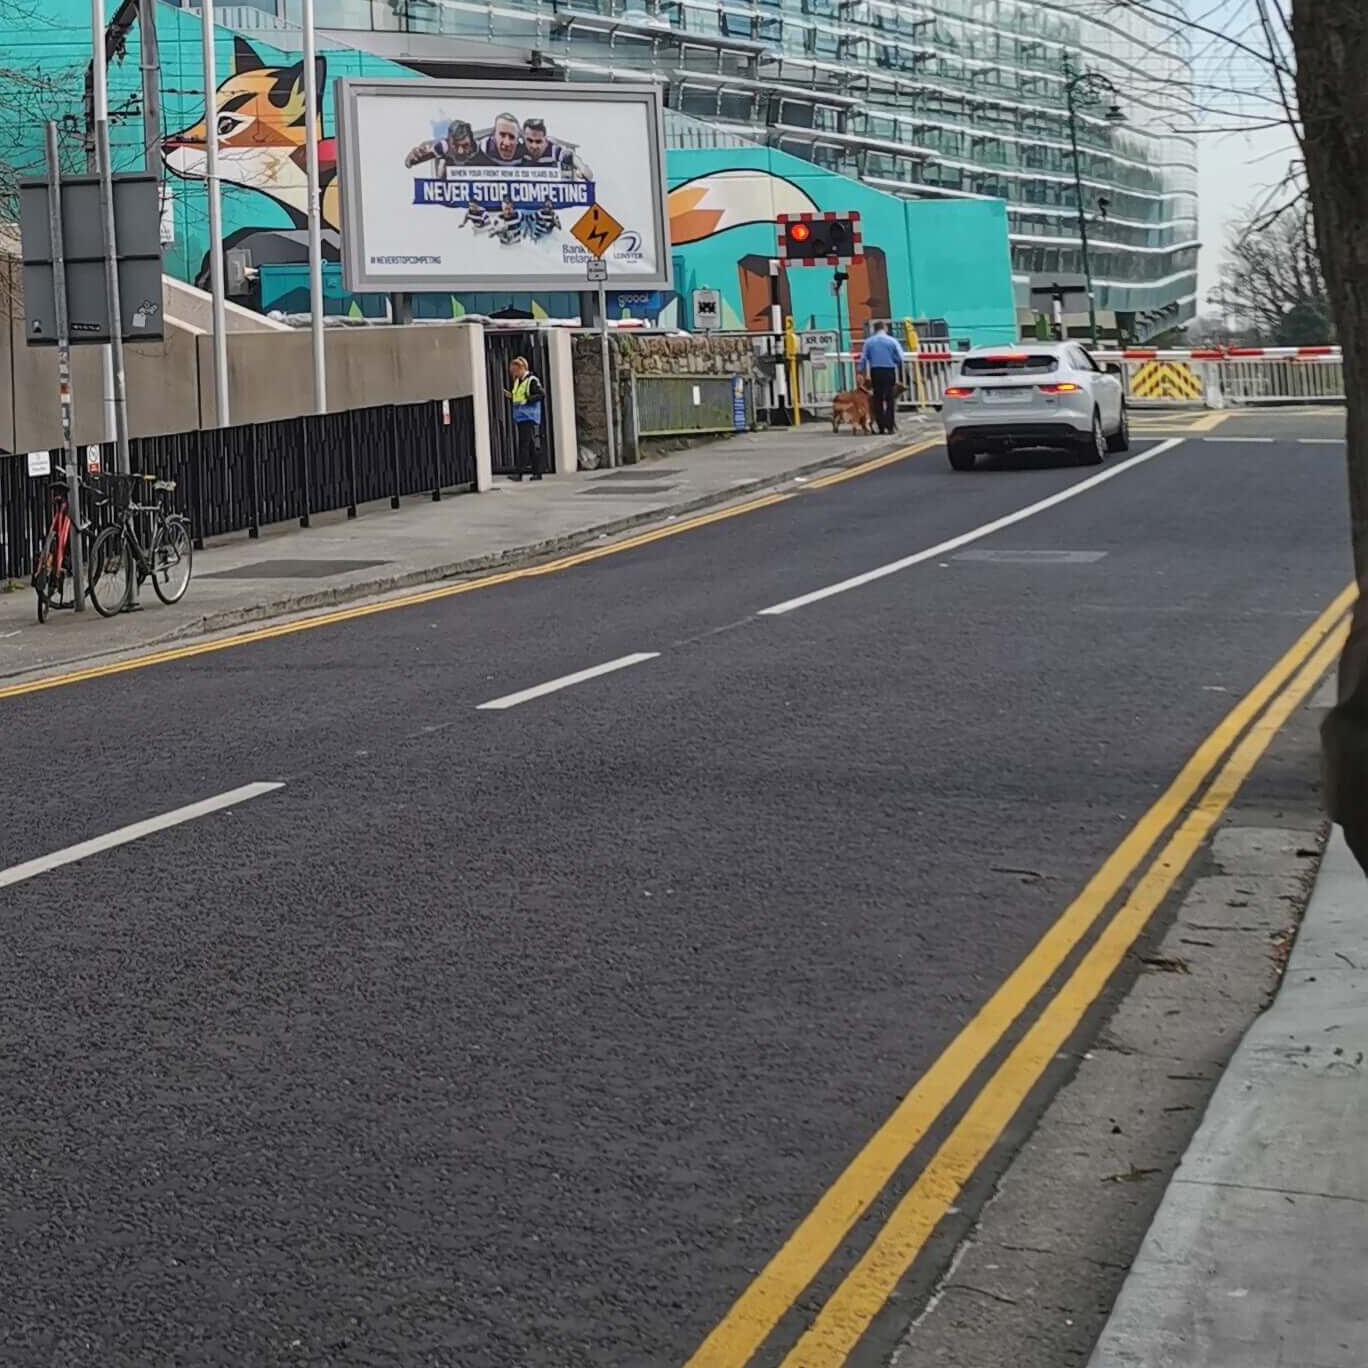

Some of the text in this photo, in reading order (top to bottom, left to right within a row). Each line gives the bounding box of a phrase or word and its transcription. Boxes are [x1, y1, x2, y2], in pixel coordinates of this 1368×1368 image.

[423, 181, 587, 203] NEVER STOP COMPETING
